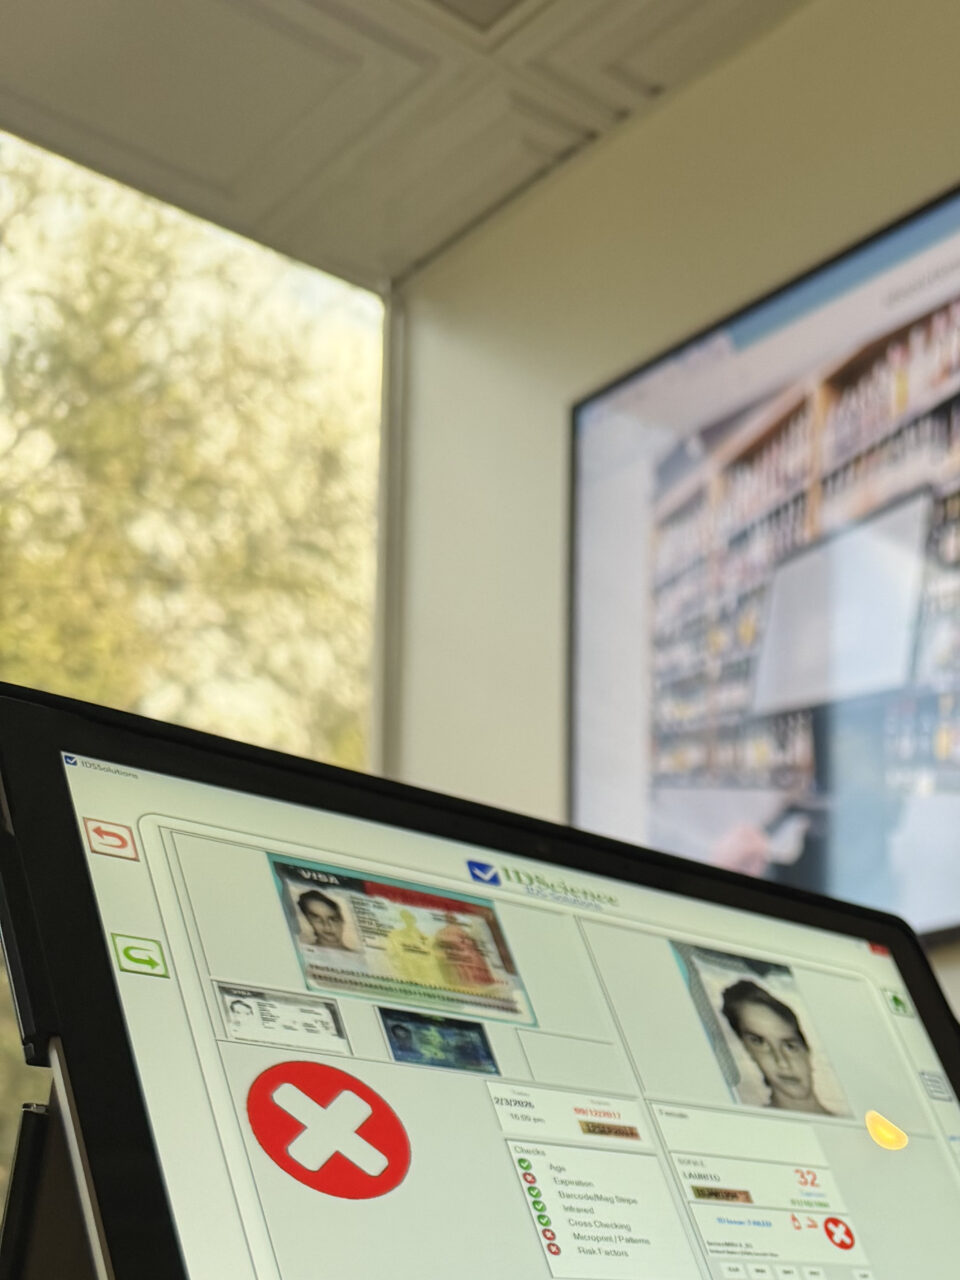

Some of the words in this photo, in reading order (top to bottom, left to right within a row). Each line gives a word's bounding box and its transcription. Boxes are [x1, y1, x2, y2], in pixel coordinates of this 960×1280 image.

[301, 870, 340, 886] VISA
[503, 866, 620, 908] IDScience
[549, 1163, 566, 1174] Age
[553, 1176, 595, 1188] Expiration
[794, 1168, 821, 1188] 32
[562, 1204, 595, 1215] Infrared
[568, 1218, 592, 1229] Cross
[593, 1221, 632, 1232] Checking
[577, 1246, 597, 1256] Risk
[596, 1247, 630, 1258] Factors
